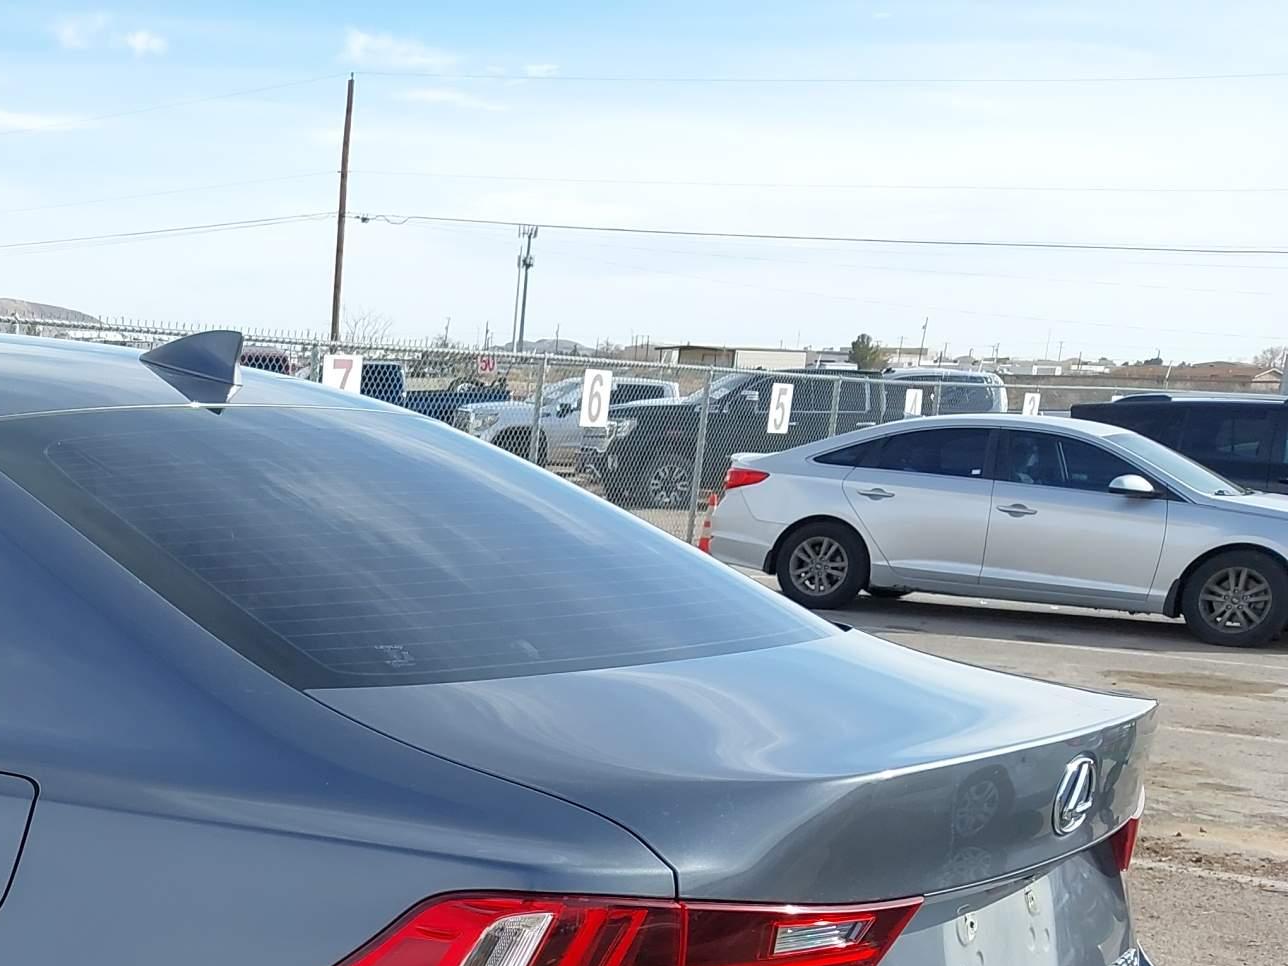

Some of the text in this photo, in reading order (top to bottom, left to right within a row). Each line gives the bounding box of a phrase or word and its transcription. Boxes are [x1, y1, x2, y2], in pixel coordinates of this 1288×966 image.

[333, 358, 354, 390] 7
[588, 373, 604, 423] 6
[773, 387, 788, 431] 5
